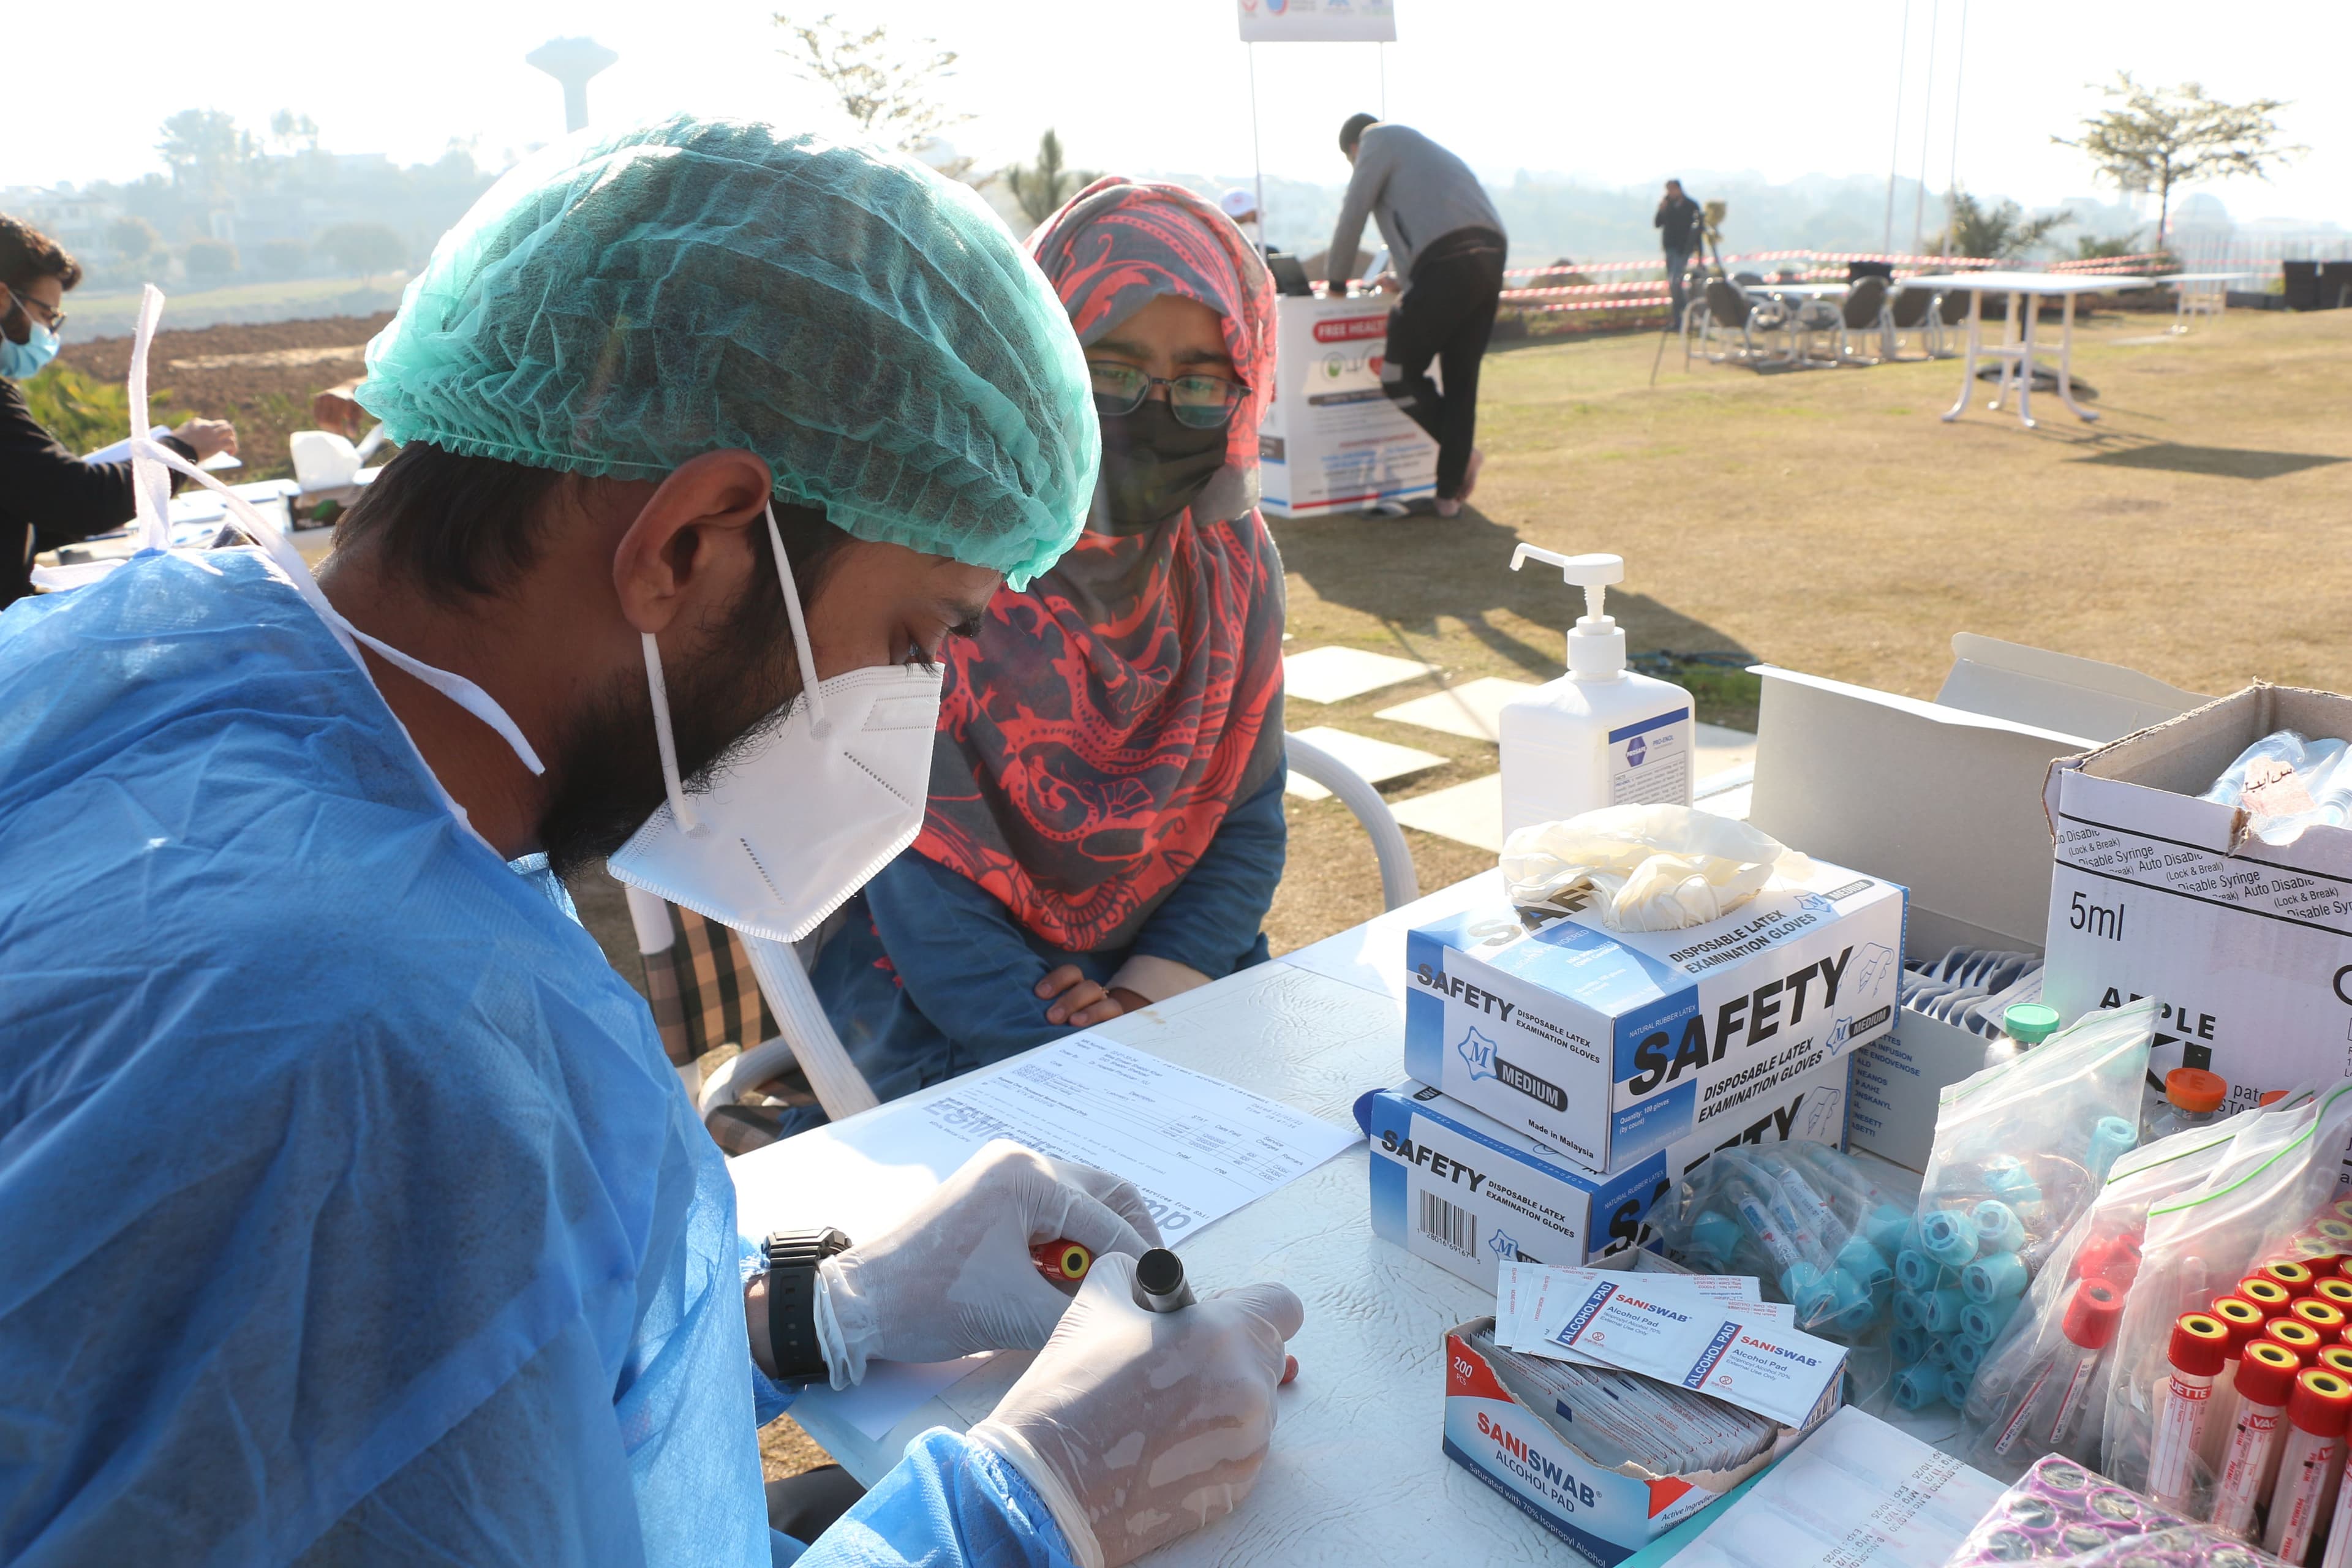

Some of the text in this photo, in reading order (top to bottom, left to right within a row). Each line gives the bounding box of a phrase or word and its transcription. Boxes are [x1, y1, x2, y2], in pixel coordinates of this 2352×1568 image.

[1318, 320, 1387, 336] FREE HEALT
[2068, 845, 2088, 858] (Lock
[2096, 837, 2120, 851] Break)
[2115, 846, 2154, 863] Syringe
[2139, 858, 2162, 872] Auto
[2166, 869, 2188, 882] (Lock
[1828, 880, 1869, 901] MEDIUM
[2219, 870, 2260, 889] Syringe
[2244, 883, 2269, 898] Auto
[2274, 888, 2339, 908] (Lock & Break)
[2070, 891, 2124, 941] 5ml
[1669, 910, 1787, 963] DISPOSABLE LATEX
[1684, 913, 1817, 974] EXAMINATION GLOVES
[1417, 963, 1515, 1022] SAFETY
[1518, 1009, 1591, 1048] DISPOSABLE LATEX
[1629, 945, 1854, 1096] SAFETY
[1629, 1005, 1696, 1038] NATURAL RUBBER LATEX
[1853, 1009, 1887, 1035] MEDIUM
[1516, 1020, 1600, 1064] EXAMINATION GLOVES
[1879, 1045, 1912, 1062] INFUSION
[1703, 1036, 1814, 1102] DISPOSABLE LATEX
[1870, 1051, 1921, 1077] ENDOVENOSE
[1502, 1065, 1559, 1107] MEDIUM
[1698, 1050, 1823, 1123] EXAMINATION GLOVES
[1619, 1098, 1669, 1125] Quantity: 100 gloves
[1630, 1117, 1645, 1130] count)
[1253, 1139, 1280, 1151] Charges
[1262, 1136, 1286, 1147] Service
[1528, 1118, 1594, 1159] Made in Malaysia
[1280, 1153, 1306, 1166] Remark
[1381, 1129, 1487, 1193] SAFETY
[1257, 1172, 1276, 1181] CASH
[1264, 1169, 1283, 1177] CASH
[1488, 1180, 1566, 1223] DISPOSABLE LATEX
[1604, 1170, 1665, 1210] NATURAL RUBBER LATEX
[1174, 1202, 1191, 1211] from
[1486, 1191, 1575, 1238] EXAMINATION GLOVES
[1427, 1232, 1447, 1247] 28016
[1449, 1241, 1471, 1258] 69167
[1562, 1302, 1598, 1343] ALCOHOL
[1595, 1284, 1613, 1302] PAD
[1607, 1306, 1659, 1328] Alcohol Pad
[1615, 1292, 1689, 1324] SANISWAB
[1600, 1316, 1648, 1337] External Use Only
[1603, 1311, 1661, 1335] Isopropyl Alcohol 70%
[1687, 1345, 1724, 1386] ALCOHOL
[1720, 1325, 1736, 1344] PAD
[1733, 1349, 1787, 1372] Alcohol Pad
[1740, 1335, 1817, 1368] SANISWAB
[1453, 1357, 1472, 1378] 200
[1457, 1373, 1466, 1386] PCS
[1726, 1359, 1776, 1382] External Use Only
[1729, 1354, 1790, 1380] Isopropyl Alcohol 70%
[2169, 1377, 2212, 1400] UETTE
[1477, 1412, 1594, 1508] SANISWAB
[1496, 1450, 1575, 1513] ALCOHOL PAD
[1469, 1463, 1607, 1568] Saturated with 70% Isopropyl Alcohol
[1661, 1508, 1684, 1521] Active
[2290, 1498, 2304, 1526] PREMIUM
